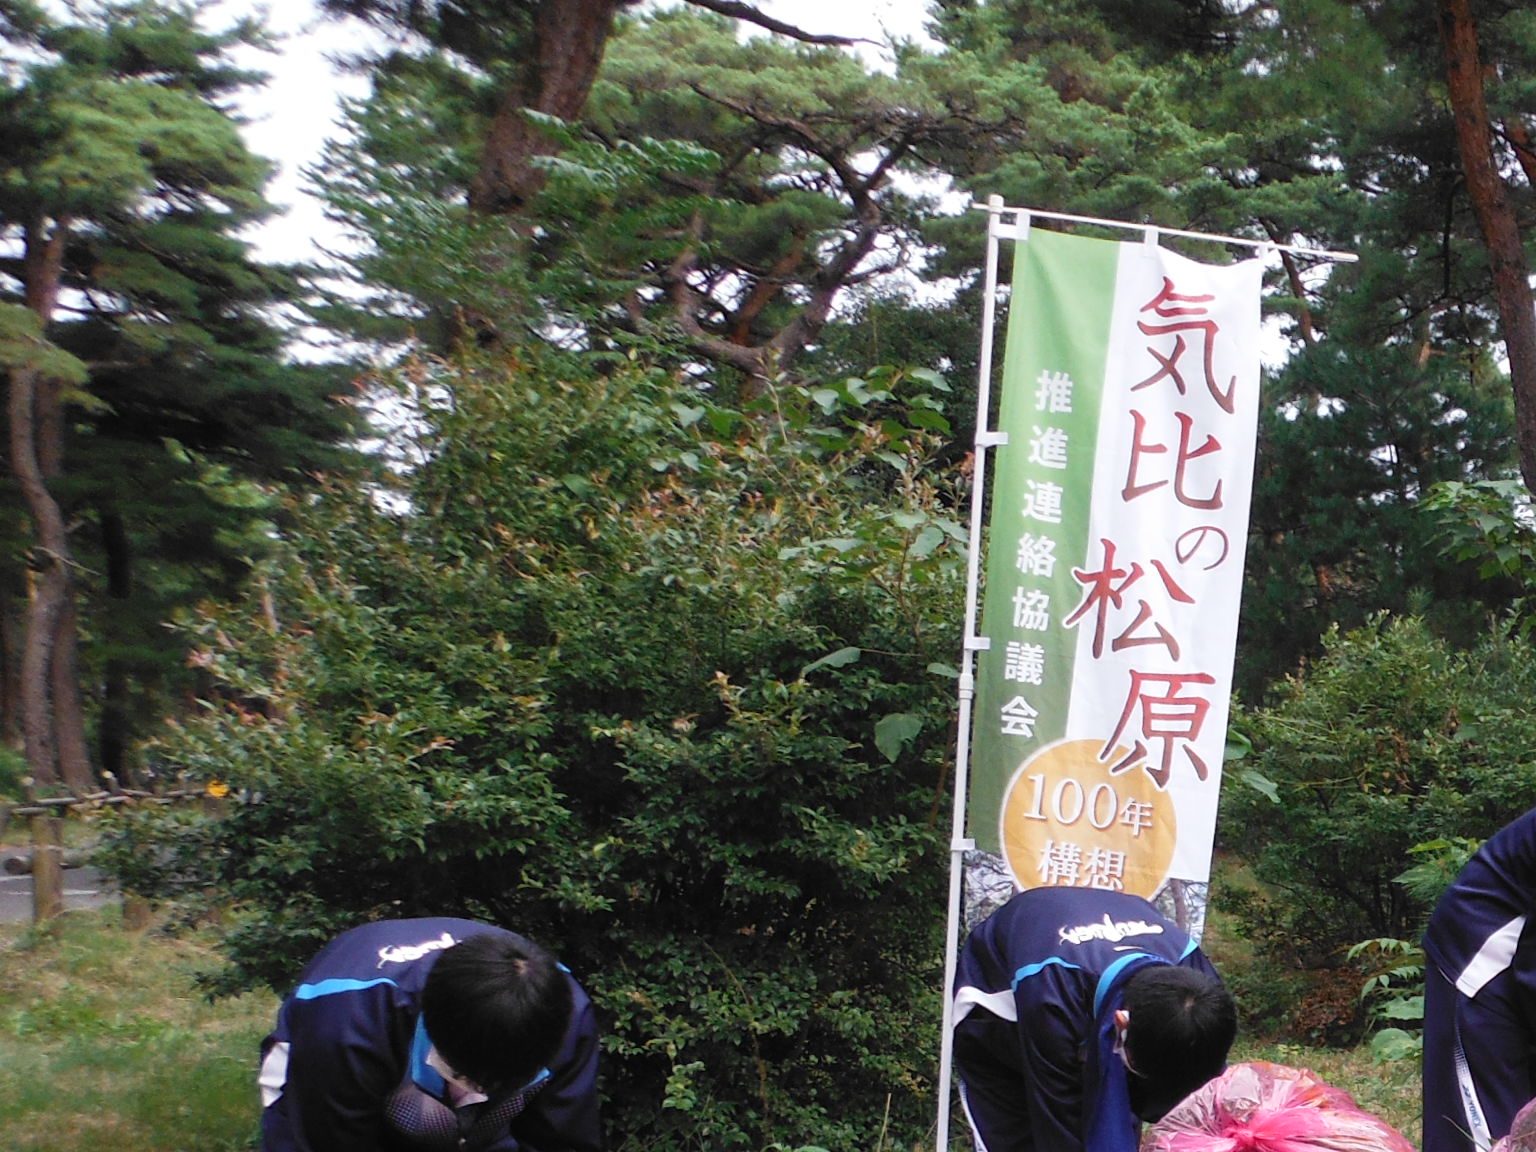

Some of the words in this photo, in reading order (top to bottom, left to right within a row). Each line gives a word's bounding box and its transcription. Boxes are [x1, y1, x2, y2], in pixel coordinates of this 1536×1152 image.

[1001, 370, 1073, 738] 推進連絡協議会
[1067, 276, 1236, 788] 気比の松原
[1023, 773, 1153, 836] 100年
[1037, 839, 1126, 890] 構想
